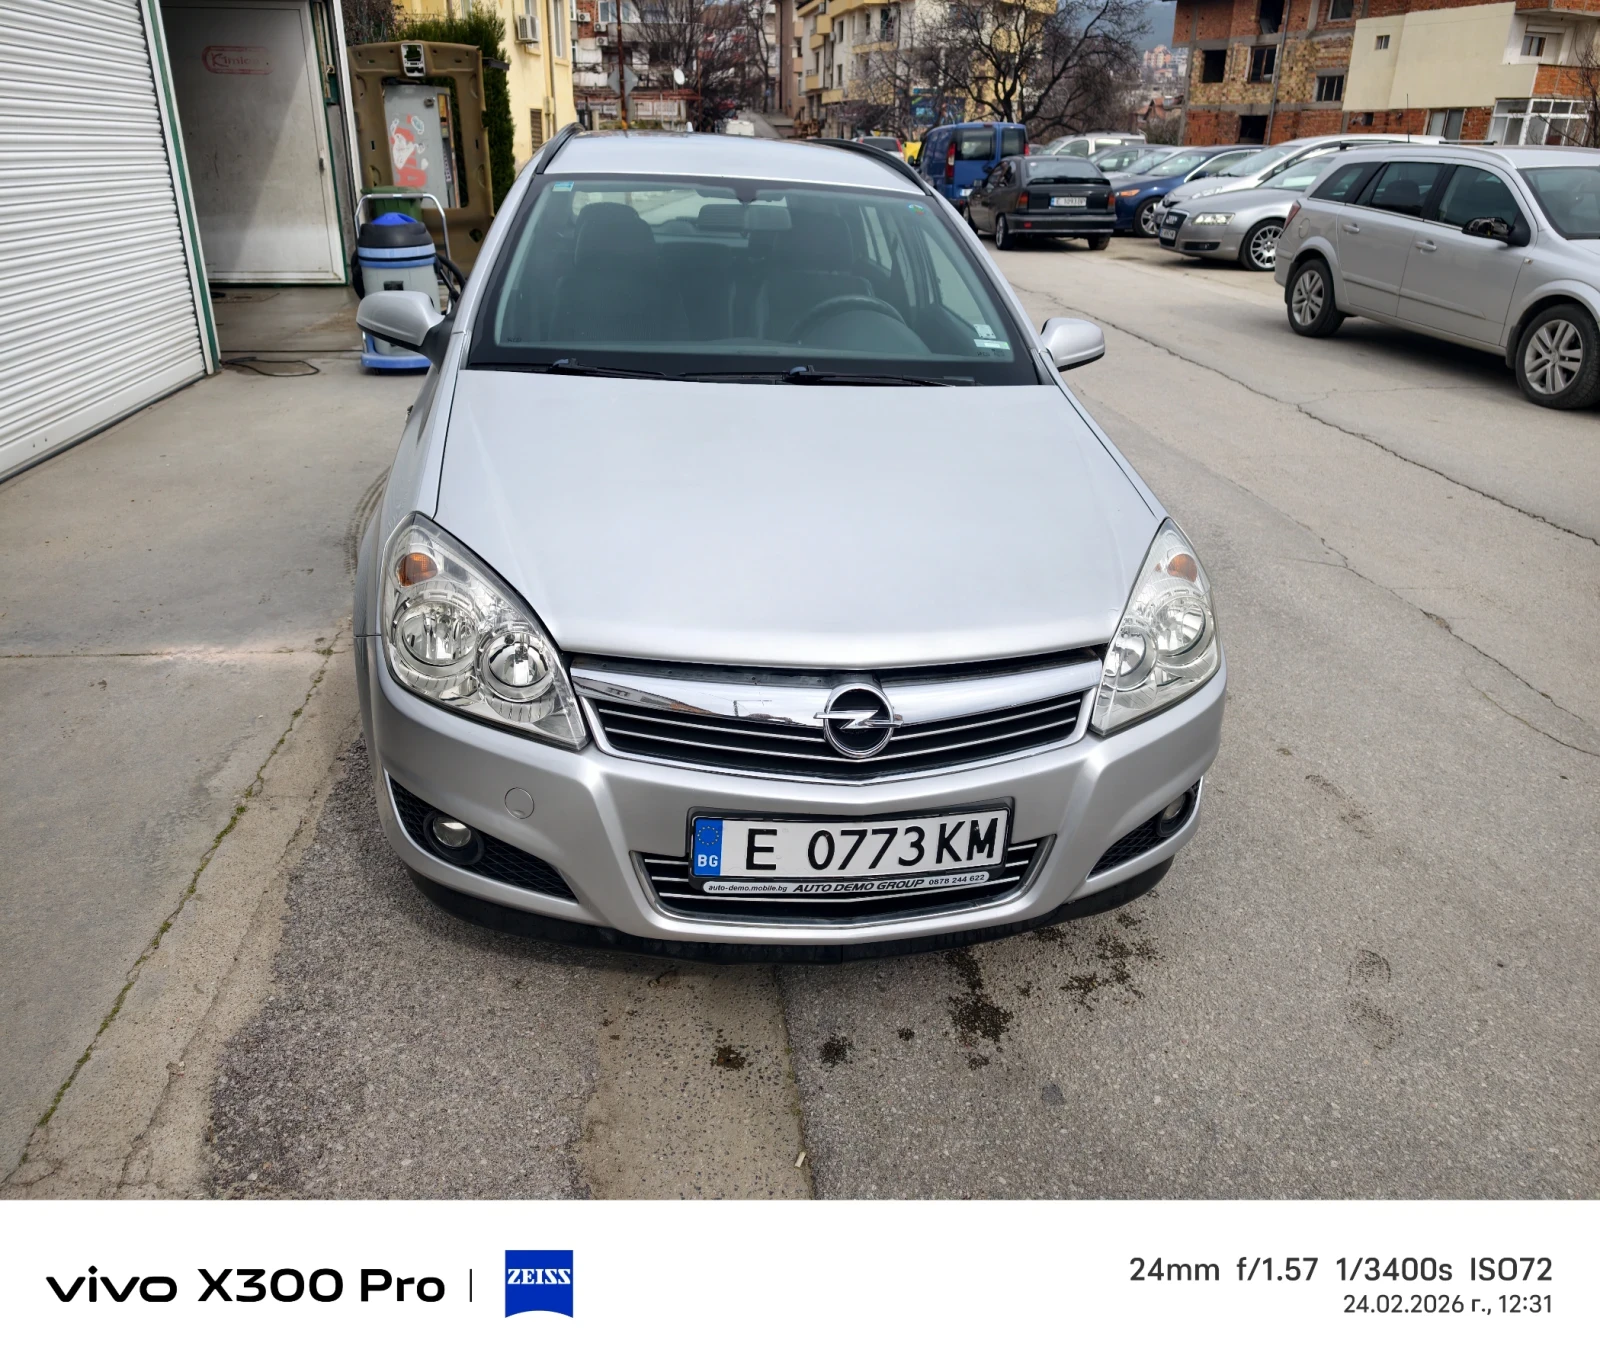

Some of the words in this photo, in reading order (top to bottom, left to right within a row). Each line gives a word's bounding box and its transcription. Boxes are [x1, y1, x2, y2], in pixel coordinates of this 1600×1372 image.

[746, 828, 777, 870] E
[808, 825, 926, 870] 0773
[935, 817, 998, 864] KM
[697, 854, 719, 868] BG
[708, 885, 788, 893] auto-demo.mobile.bg
[792, 884, 832, 893] AUTO
[833, 881, 874, 892] DEMO
[876, 879, 925, 890] GROUP
[928, 878, 950, 886] 0878
[951, 876, 967, 884] 244
[969, 874, 985, 882] 622
